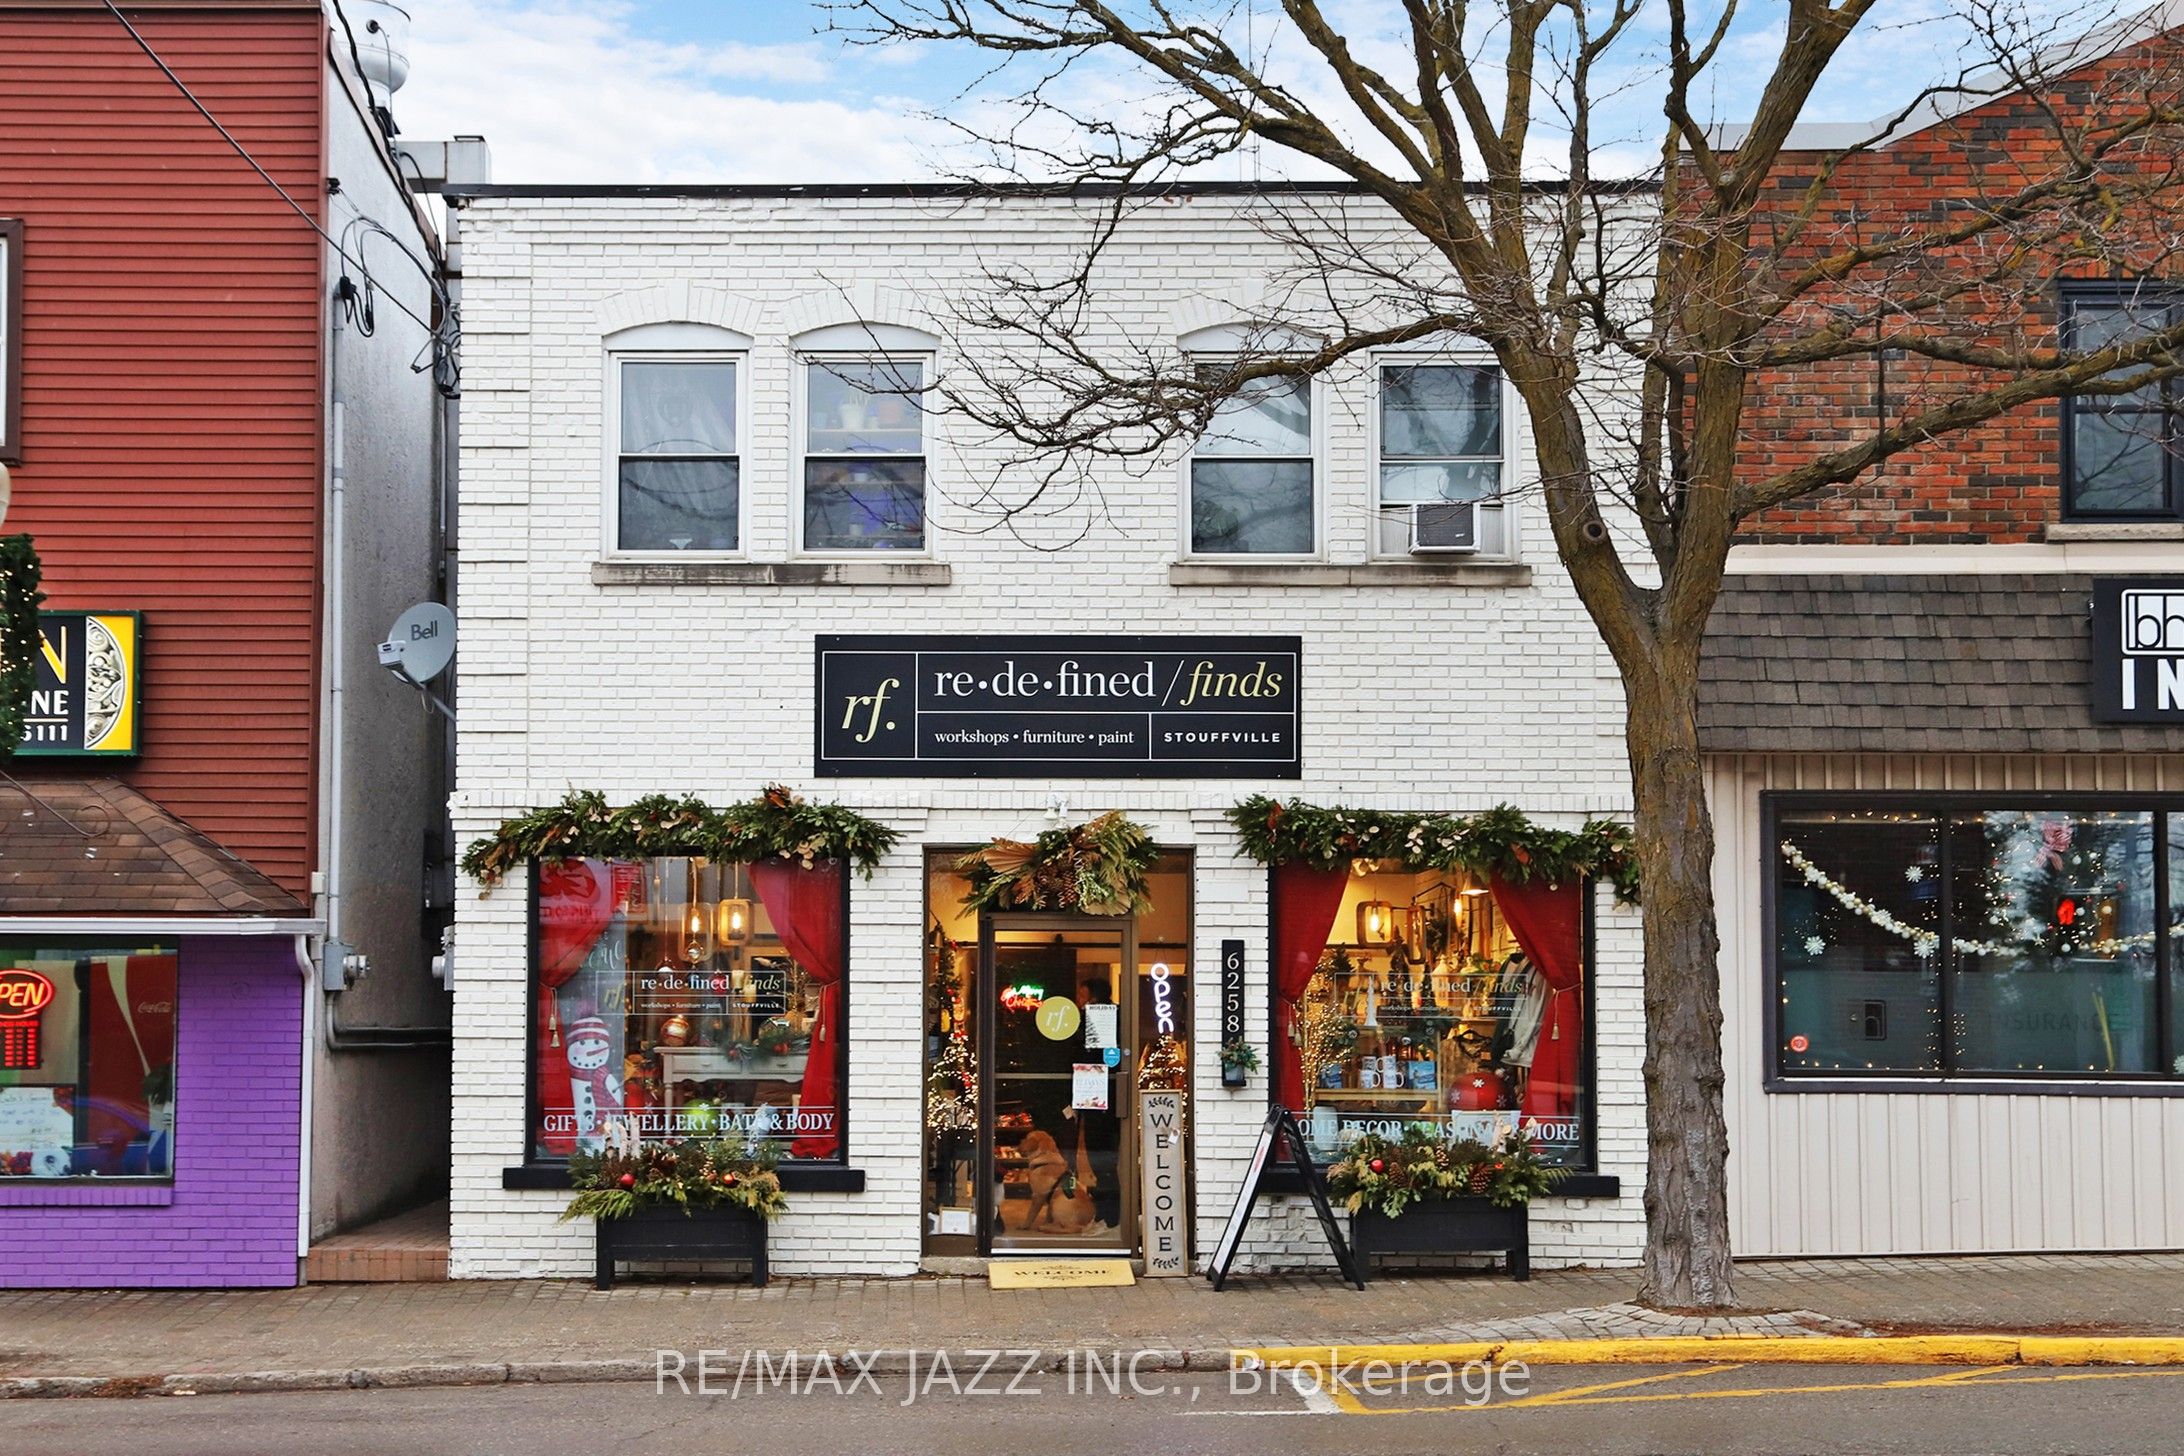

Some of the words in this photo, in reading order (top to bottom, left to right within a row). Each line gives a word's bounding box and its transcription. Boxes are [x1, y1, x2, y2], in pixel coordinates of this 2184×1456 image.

[411, 620, 438, 641] Bell
[935, 729, 1010, 746] workshops
[1022, 729, 1085, 744] furniture
[1098, 730, 1135, 747] paint
[1163, 731, 1281, 744] STOUFFVILLE
[1150, 962, 1175, 1034] open
[1226, 951, 1241, 1033] 6258
[718, 1113, 768, 1131] BAT
[770, 1113, 784, 1130] &
[786, 1113, 835, 1130] BODY
[1297, 1119, 1338, 1137] OME
[1150, 1113, 1175, 1252] WELCOME
